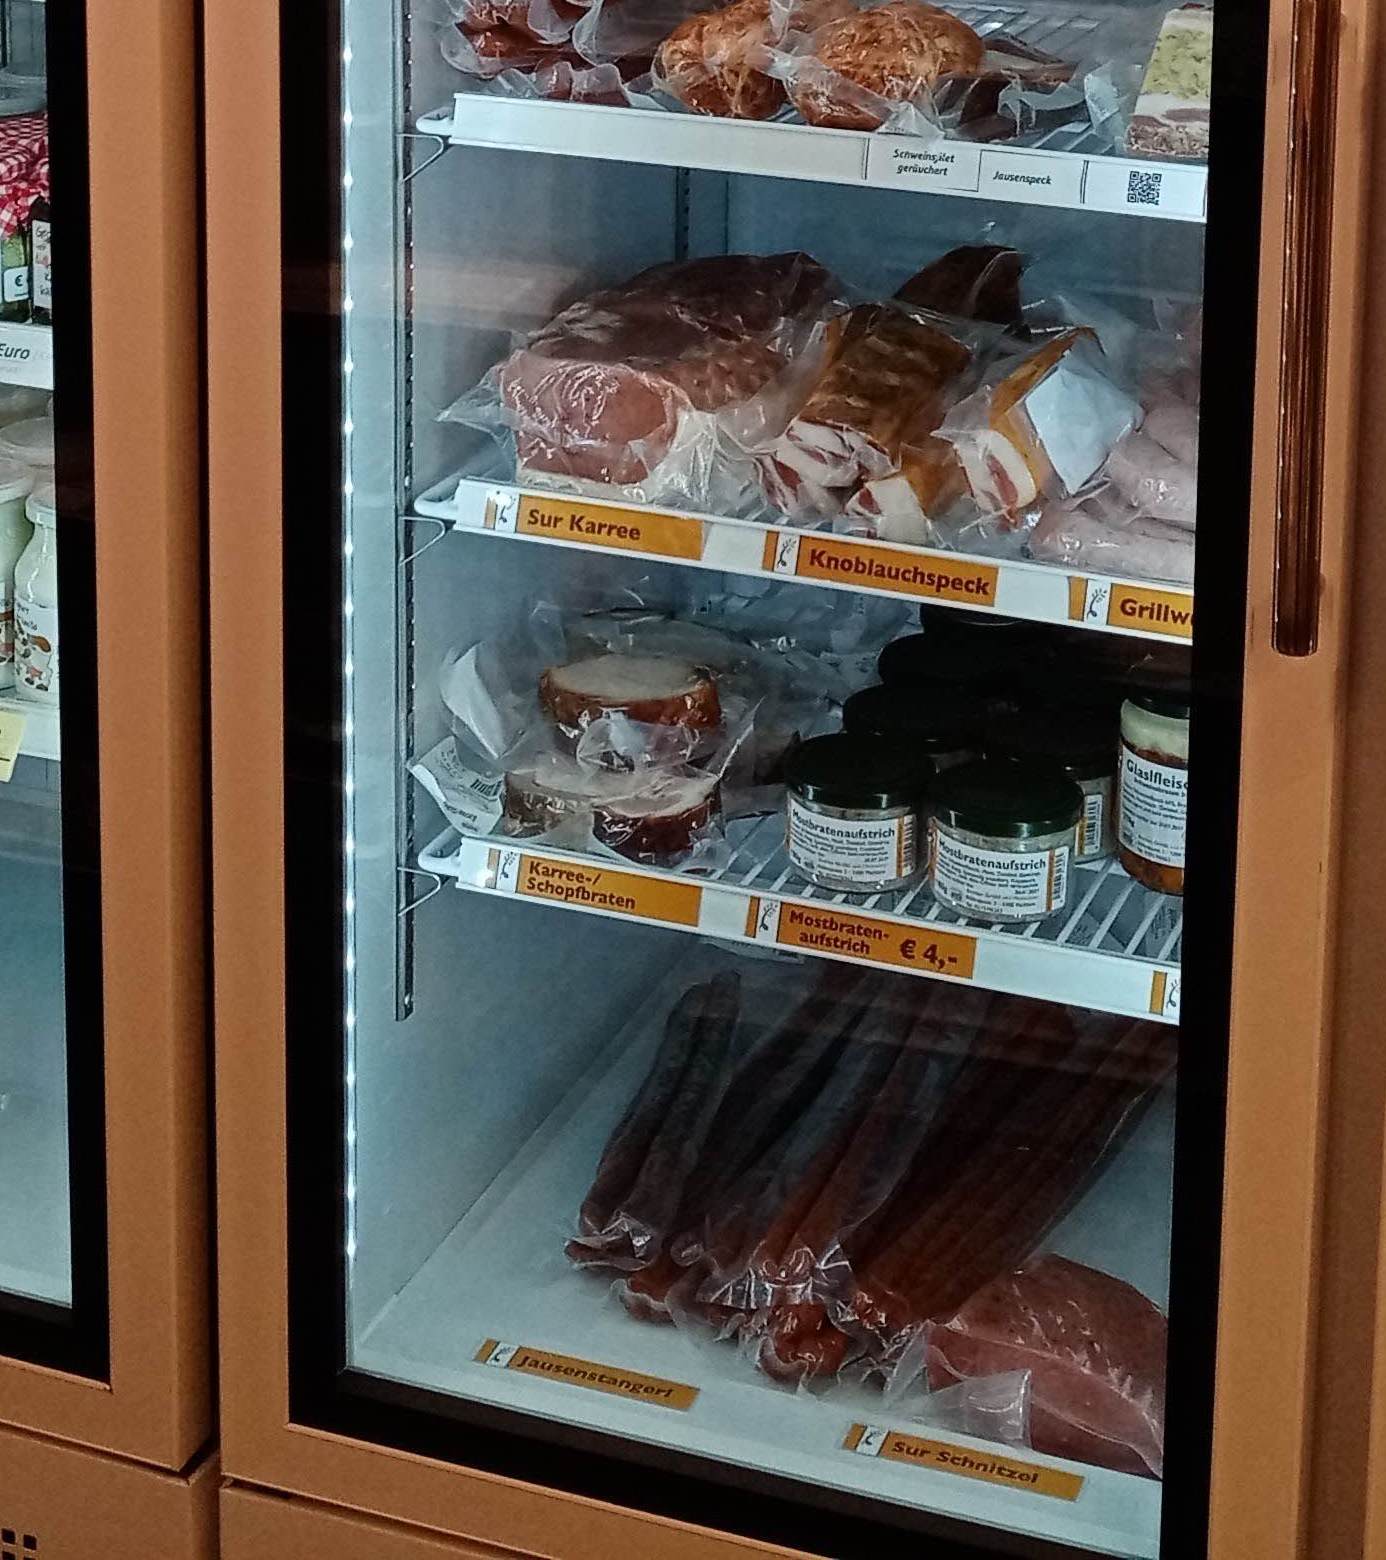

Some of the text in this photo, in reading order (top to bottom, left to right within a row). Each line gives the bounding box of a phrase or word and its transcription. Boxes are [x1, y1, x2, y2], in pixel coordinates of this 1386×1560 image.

[896, 163, 948, 177] geräuchert
[993, 170, 1052, 186] Jausenspeck
[526, 507, 642, 541] Sur Karree
[809, 547, 991, 597] Knoblauchspeck
[1118, 596, 1193, 625] Grillw
[937, 839, 1047, 871] Mostbratenaufstrich
[529, 860, 601, 886] Karree-/
[526, 876, 637, 910] Schopfbraten
[788, 909, 891, 941] Mostbraten-
[798, 929, 872, 956] aufstrich
[900, 940, 917, 960] €
[515, 1353, 675, 1400] Jausenstangerl
[890, 1440, 1041, 1485] Sur Schnitzel
